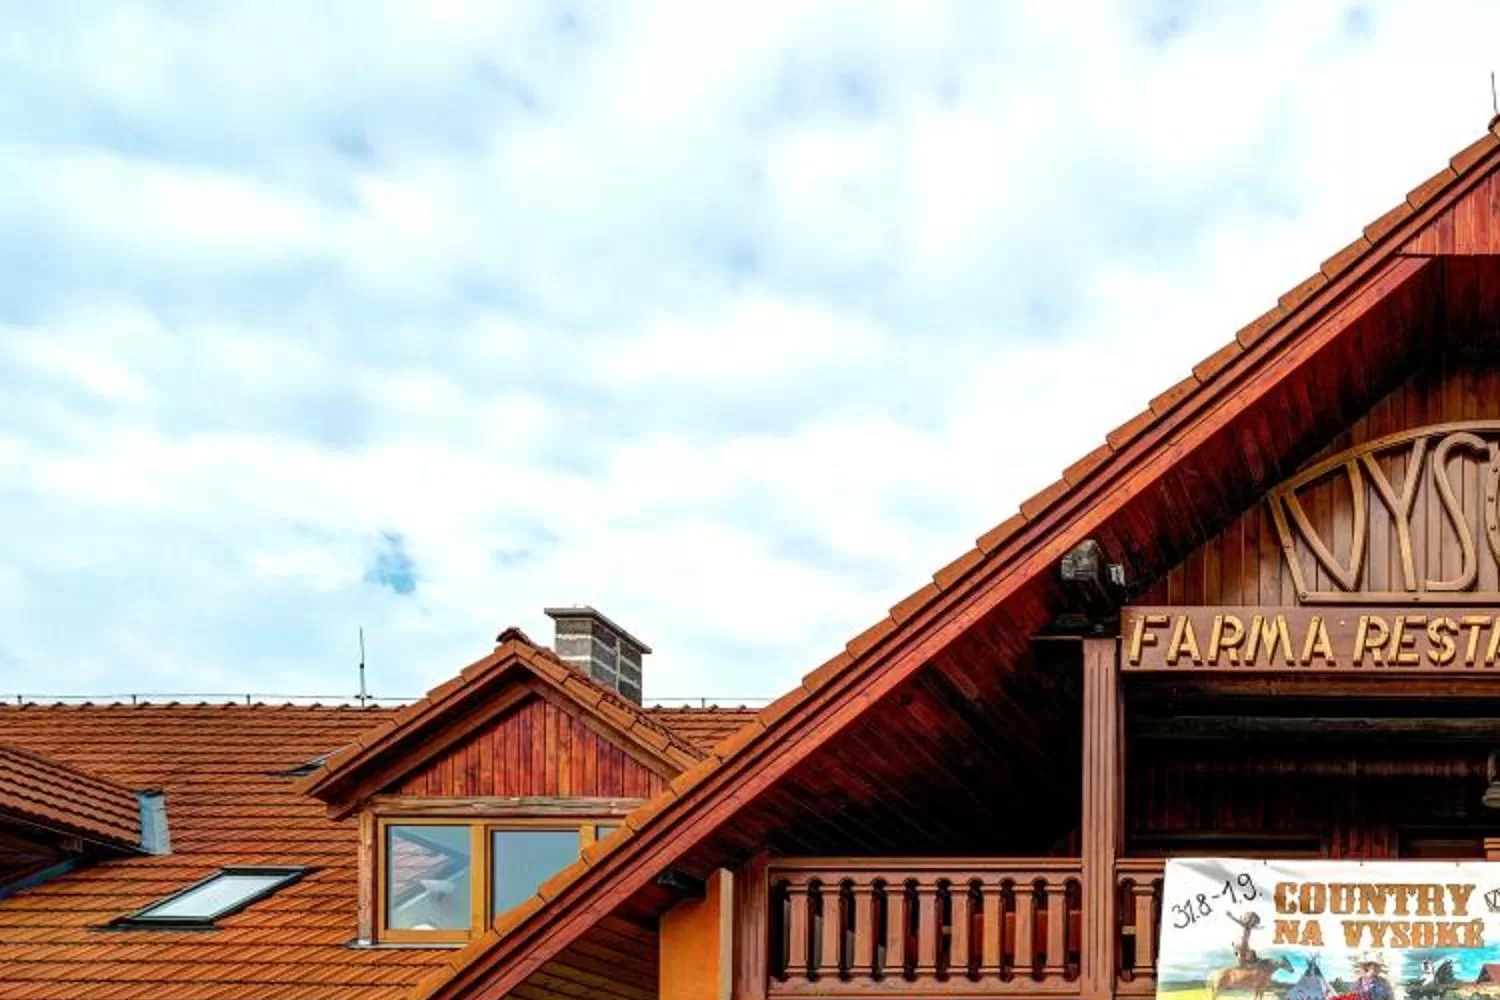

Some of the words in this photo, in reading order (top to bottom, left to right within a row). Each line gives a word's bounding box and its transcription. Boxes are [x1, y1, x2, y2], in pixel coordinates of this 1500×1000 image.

[1128, 614, 1336, 667] FARMA
[1273, 881, 1477, 916] COUNTRY
[1273, 919, 1325, 947] NA
[1340, 917, 1486, 949] VYSOKÉ
